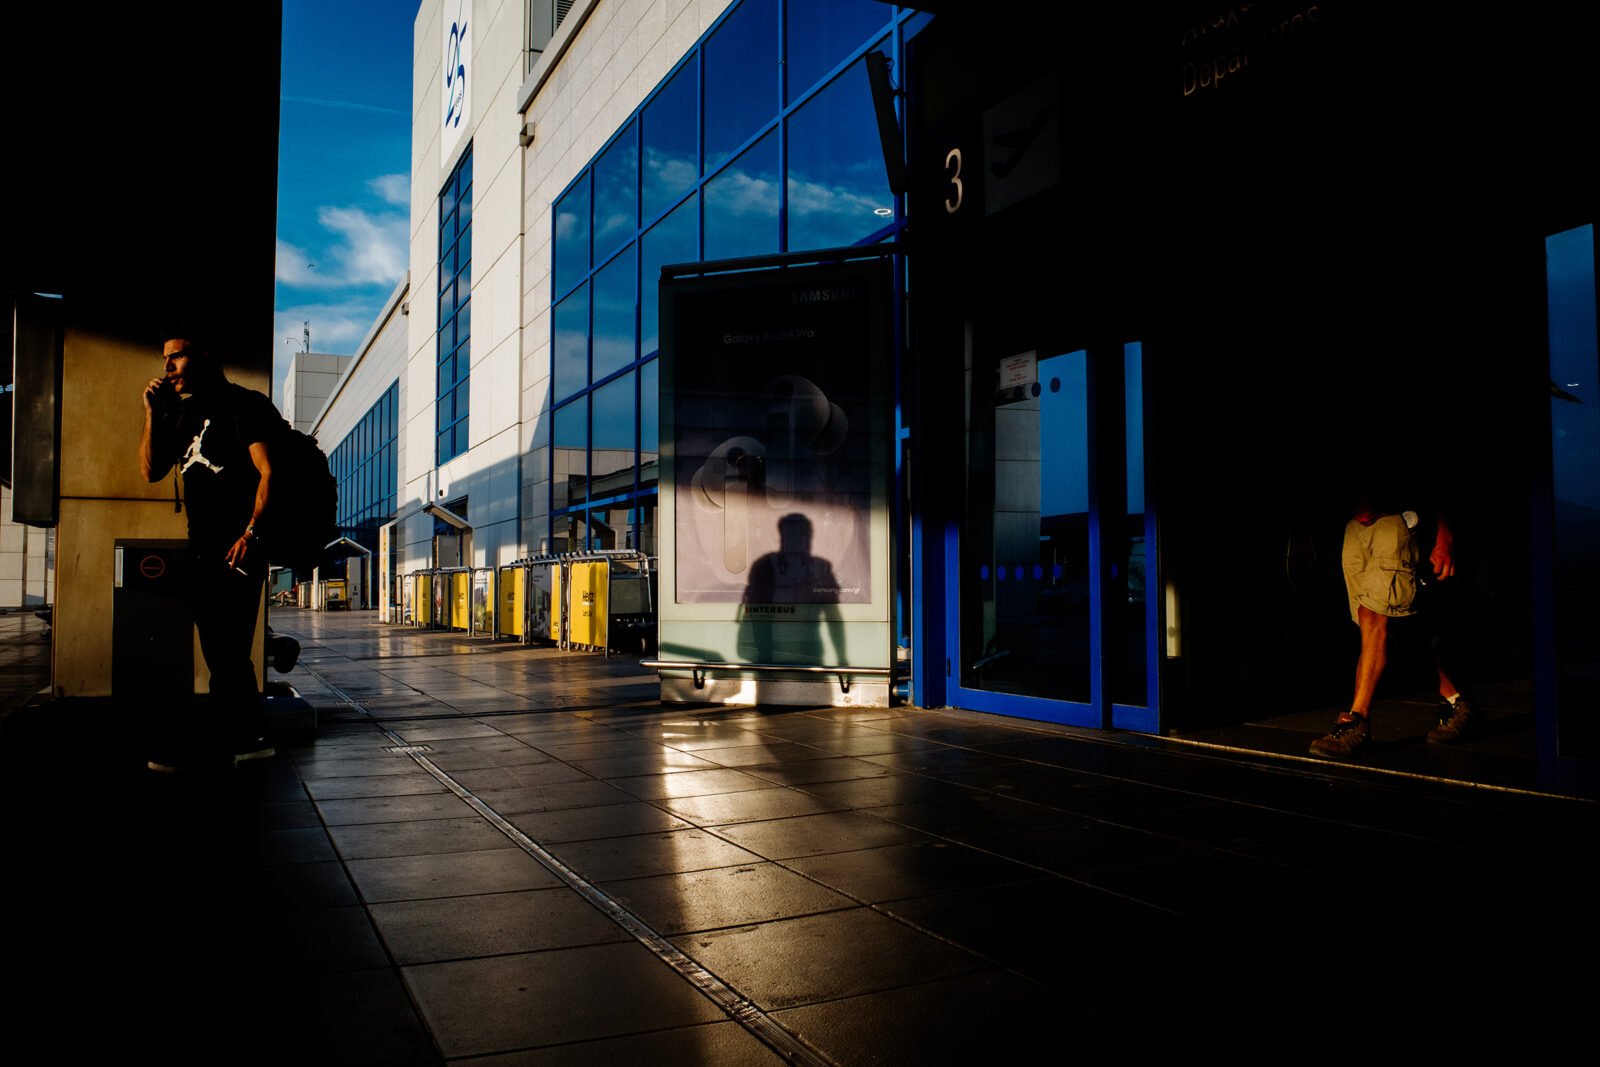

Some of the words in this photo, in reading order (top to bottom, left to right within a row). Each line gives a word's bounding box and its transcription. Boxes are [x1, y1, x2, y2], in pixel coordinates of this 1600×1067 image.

[943, 147, 964, 214] 3
[723, 331, 760, 345] Galaxy
[797, 328, 815, 339] Pro
[749, 606, 796, 614] INTERBUS
